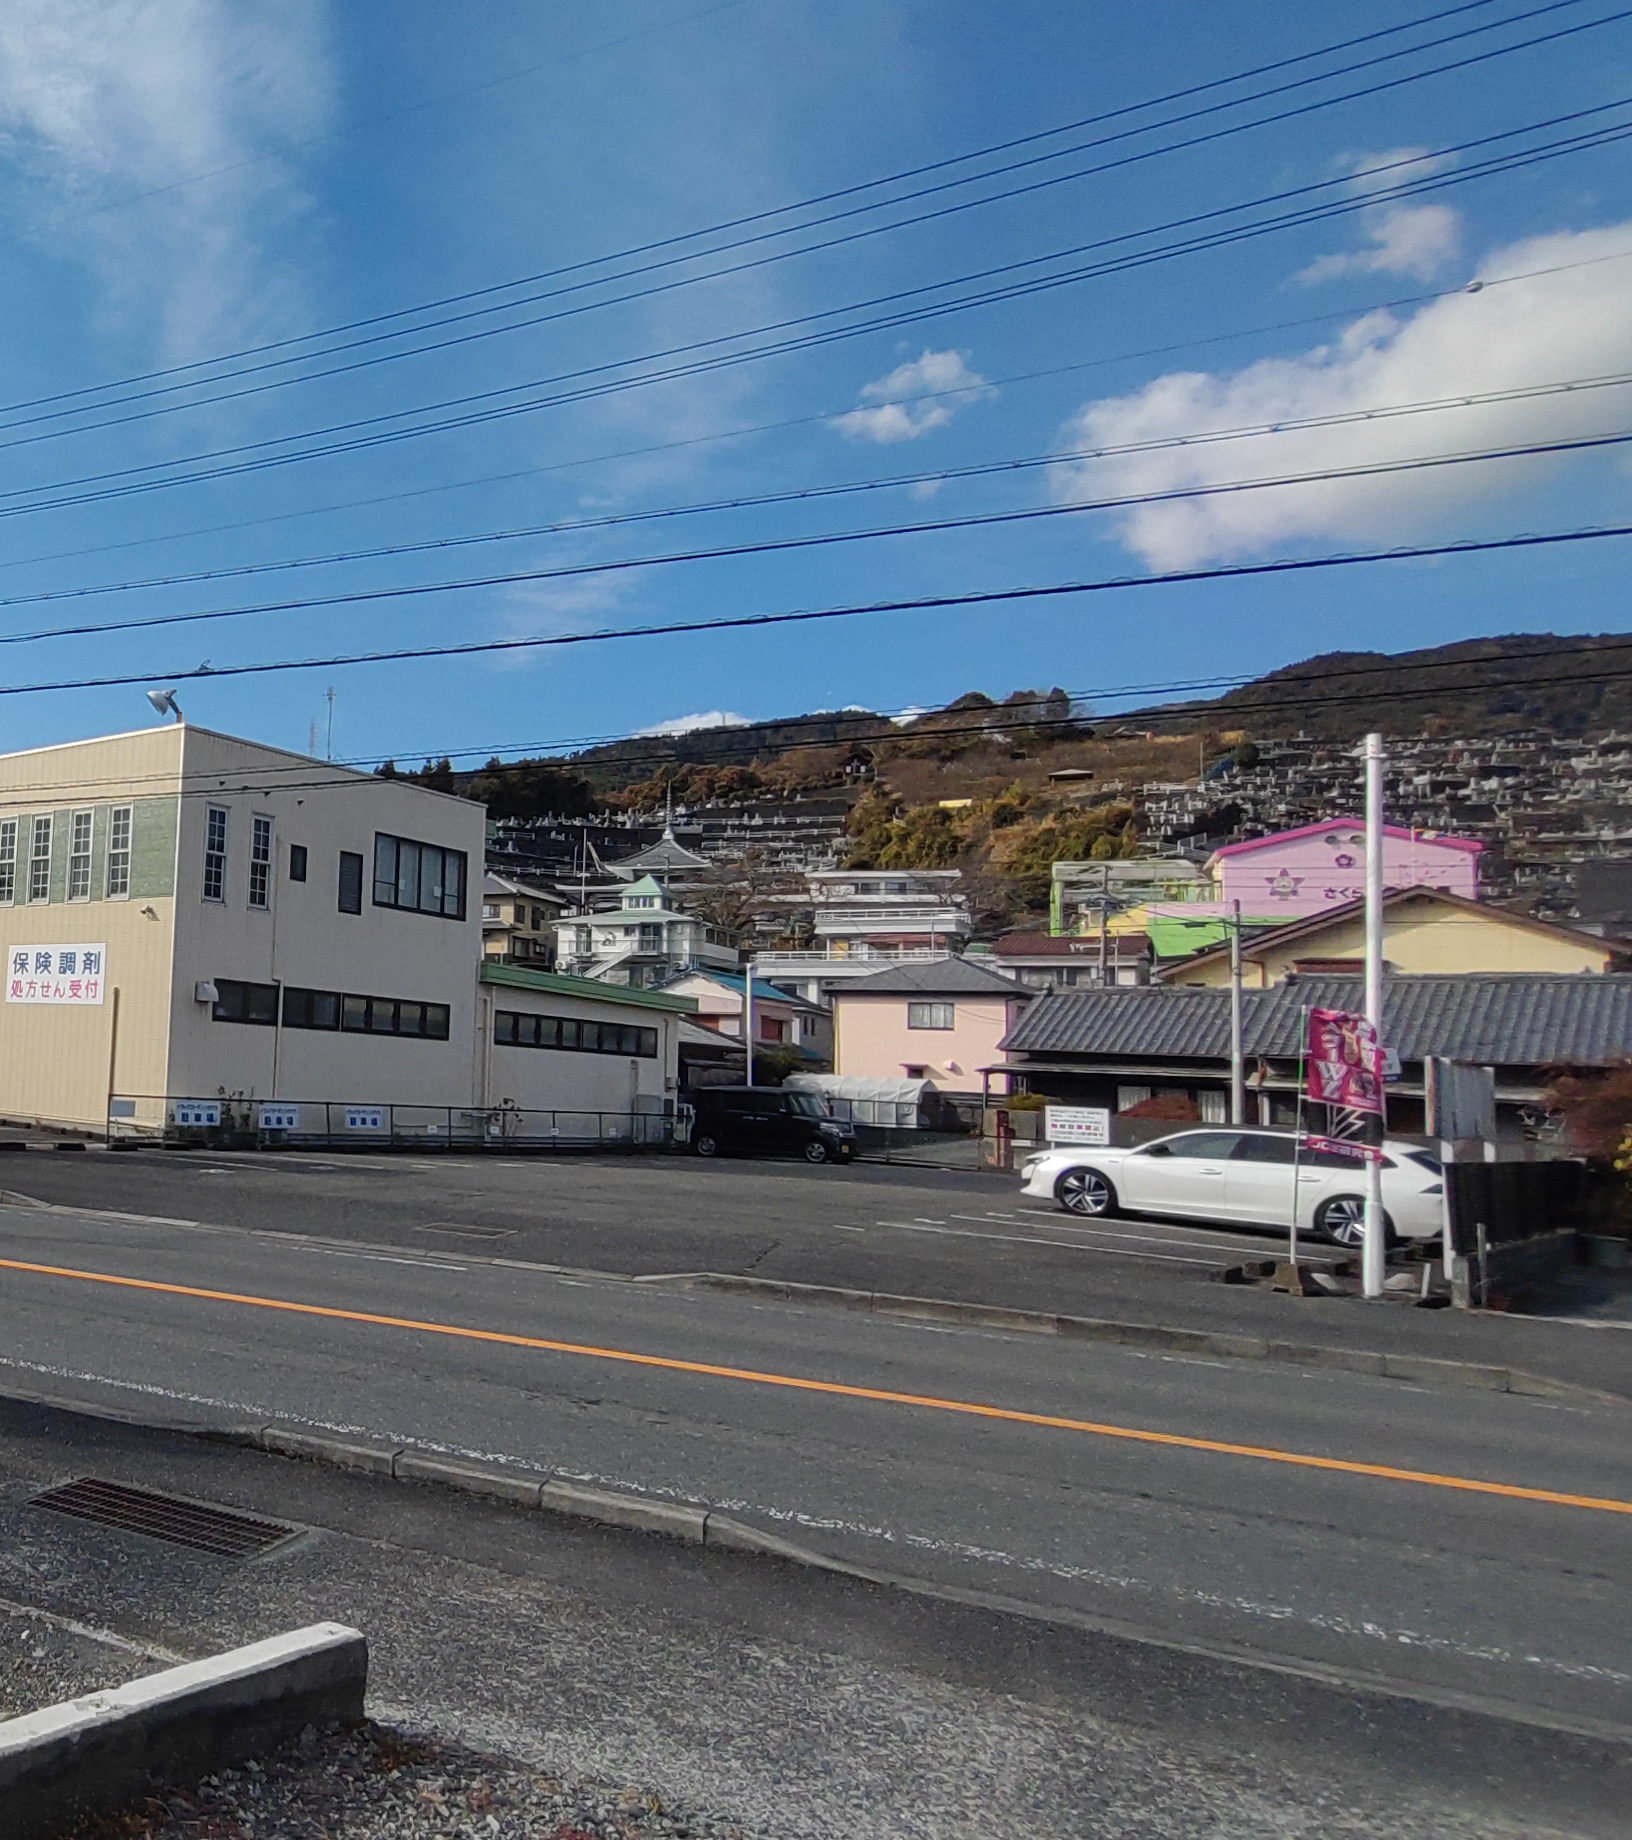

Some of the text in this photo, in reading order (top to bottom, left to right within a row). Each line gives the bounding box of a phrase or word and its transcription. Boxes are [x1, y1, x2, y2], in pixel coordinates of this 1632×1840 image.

[12, 950, 101, 975] 保険調剤
[10, 979, 99, 999] 処方せん受付
